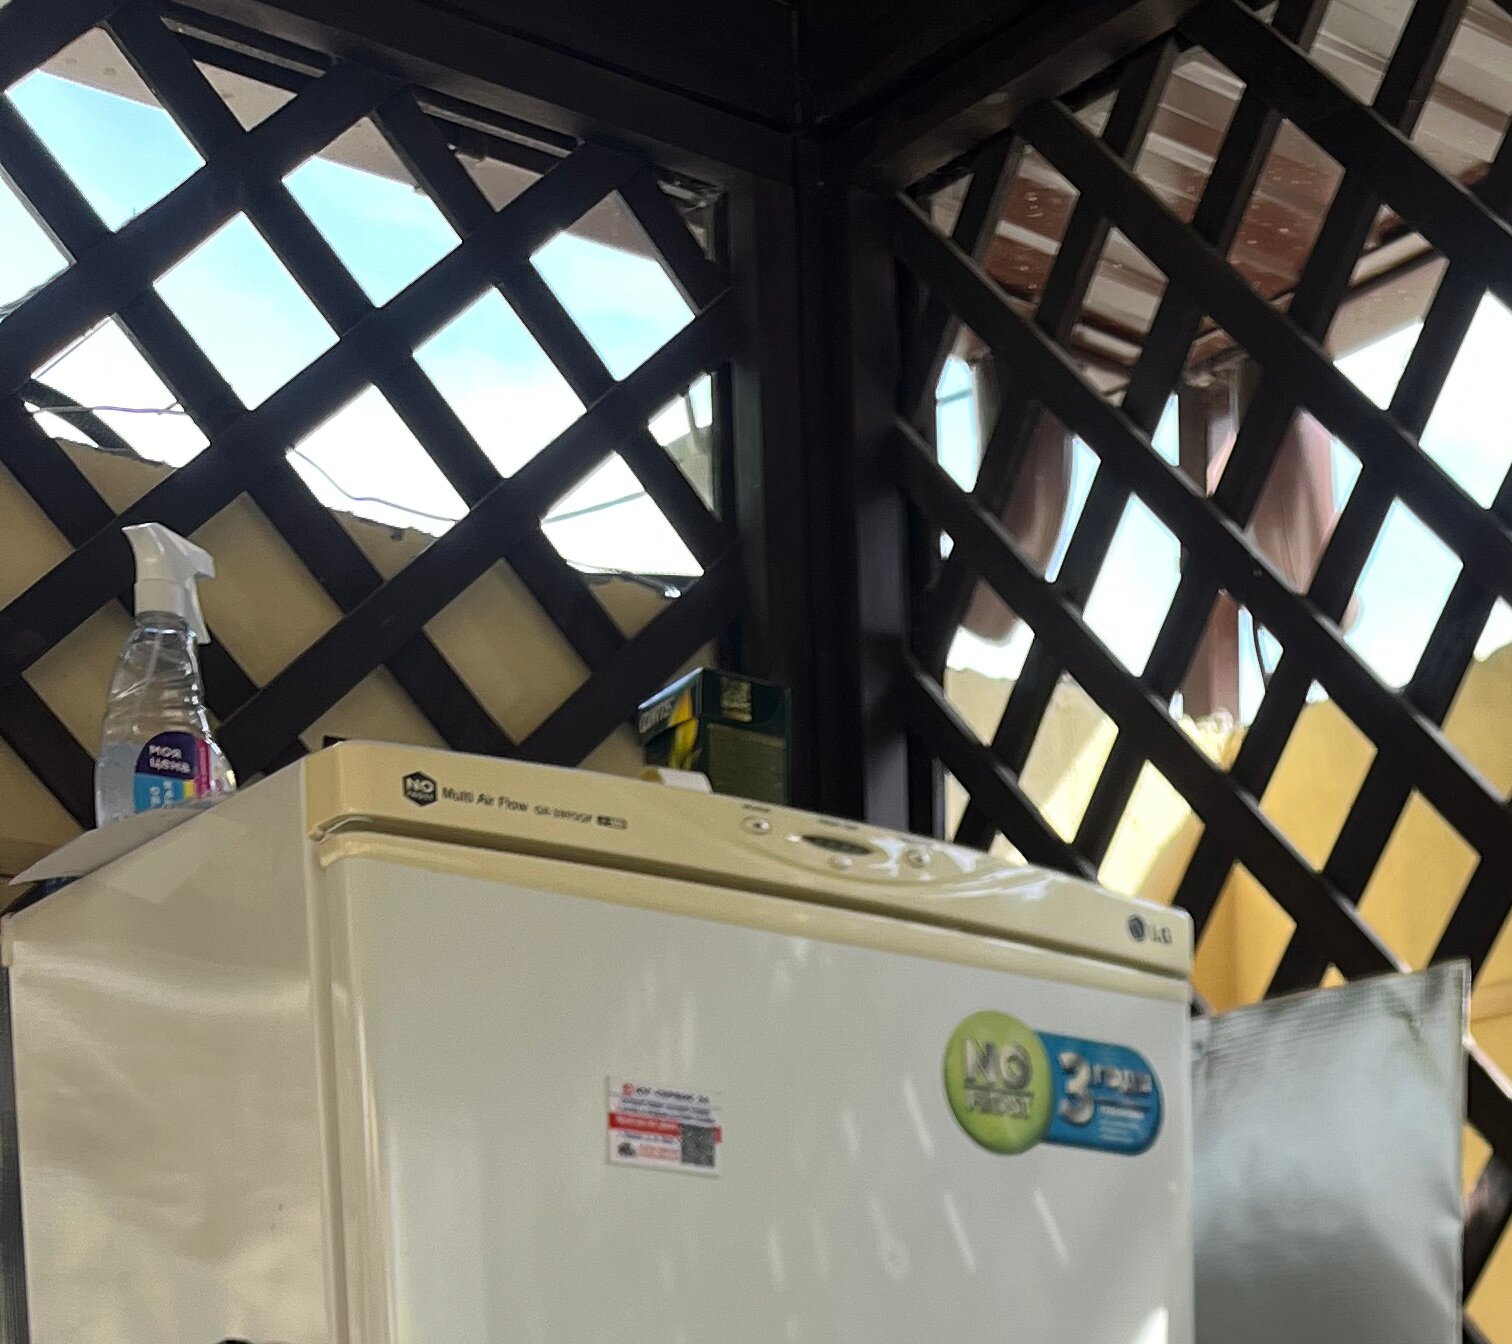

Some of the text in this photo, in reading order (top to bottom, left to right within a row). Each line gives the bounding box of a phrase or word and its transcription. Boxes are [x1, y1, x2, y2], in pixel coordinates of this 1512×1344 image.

[405, 777, 435, 793] NO
[442, 786, 527, 812] Multi Air Flow
[964, 1038, 1033, 1090] NO
[1058, 1052, 1095, 1125] 3
